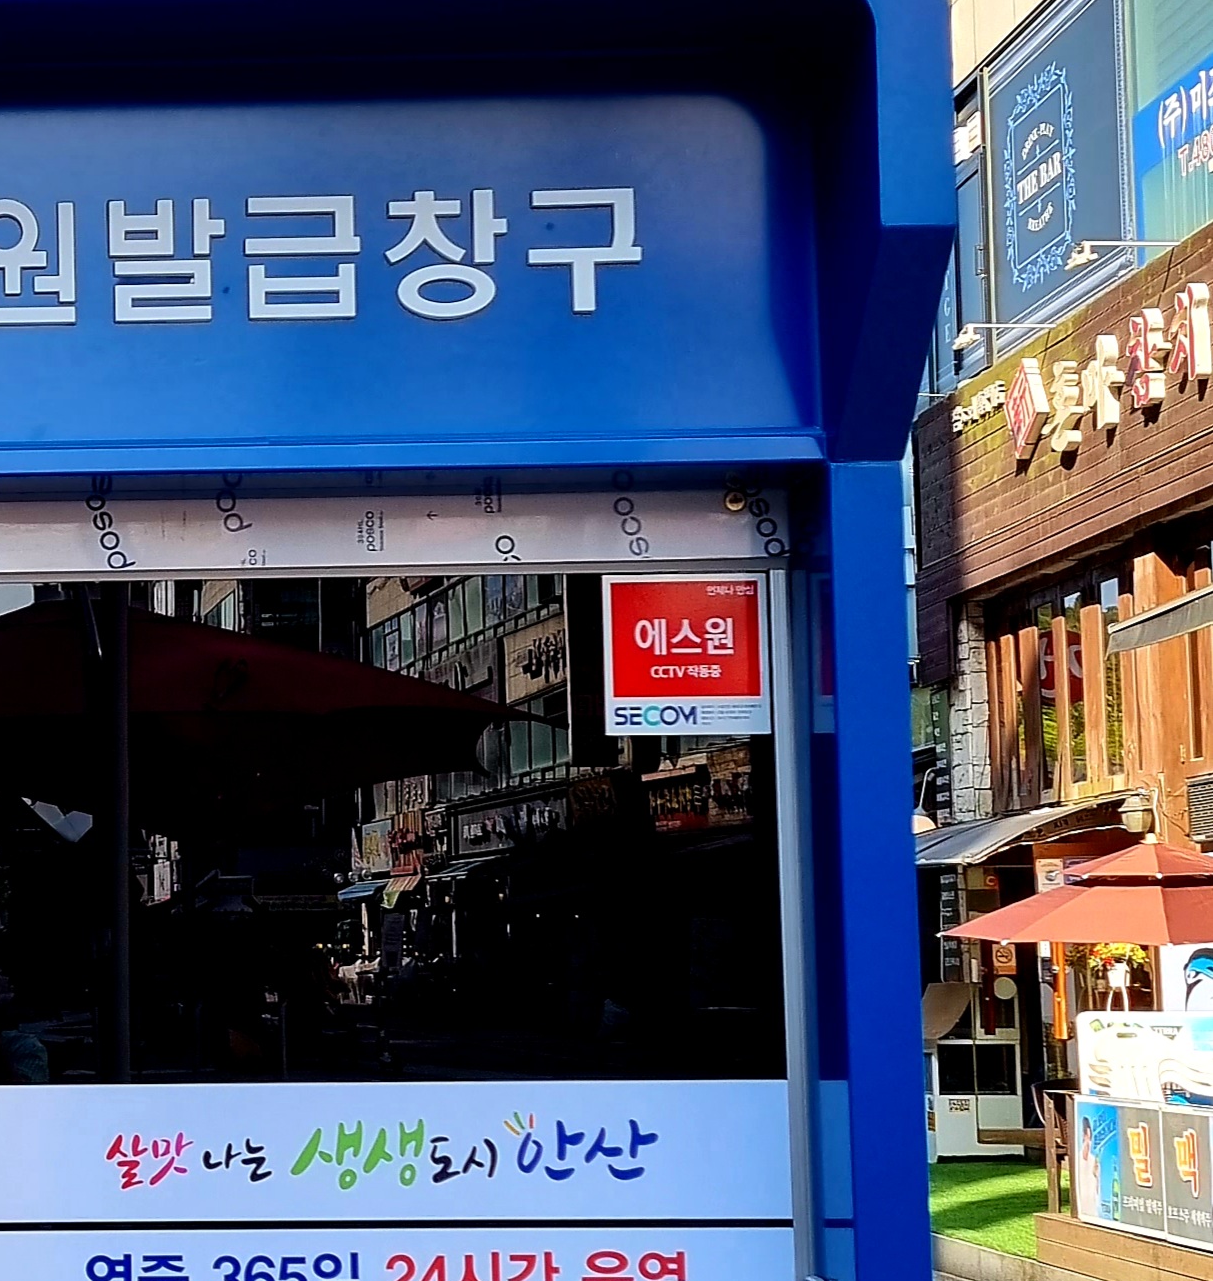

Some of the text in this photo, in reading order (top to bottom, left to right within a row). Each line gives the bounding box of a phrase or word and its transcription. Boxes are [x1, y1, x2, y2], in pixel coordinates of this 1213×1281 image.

[1016, 151, 1062, 206] THE BAR
[634, 616, 736, 657] 에스원
[650, 664, 723, 679] CCTV 작동중
[614, 704, 698, 727] SECOM
[515, 1117, 659, 1181] 안산
[1173, 1128, 1200, 1199] 맥
